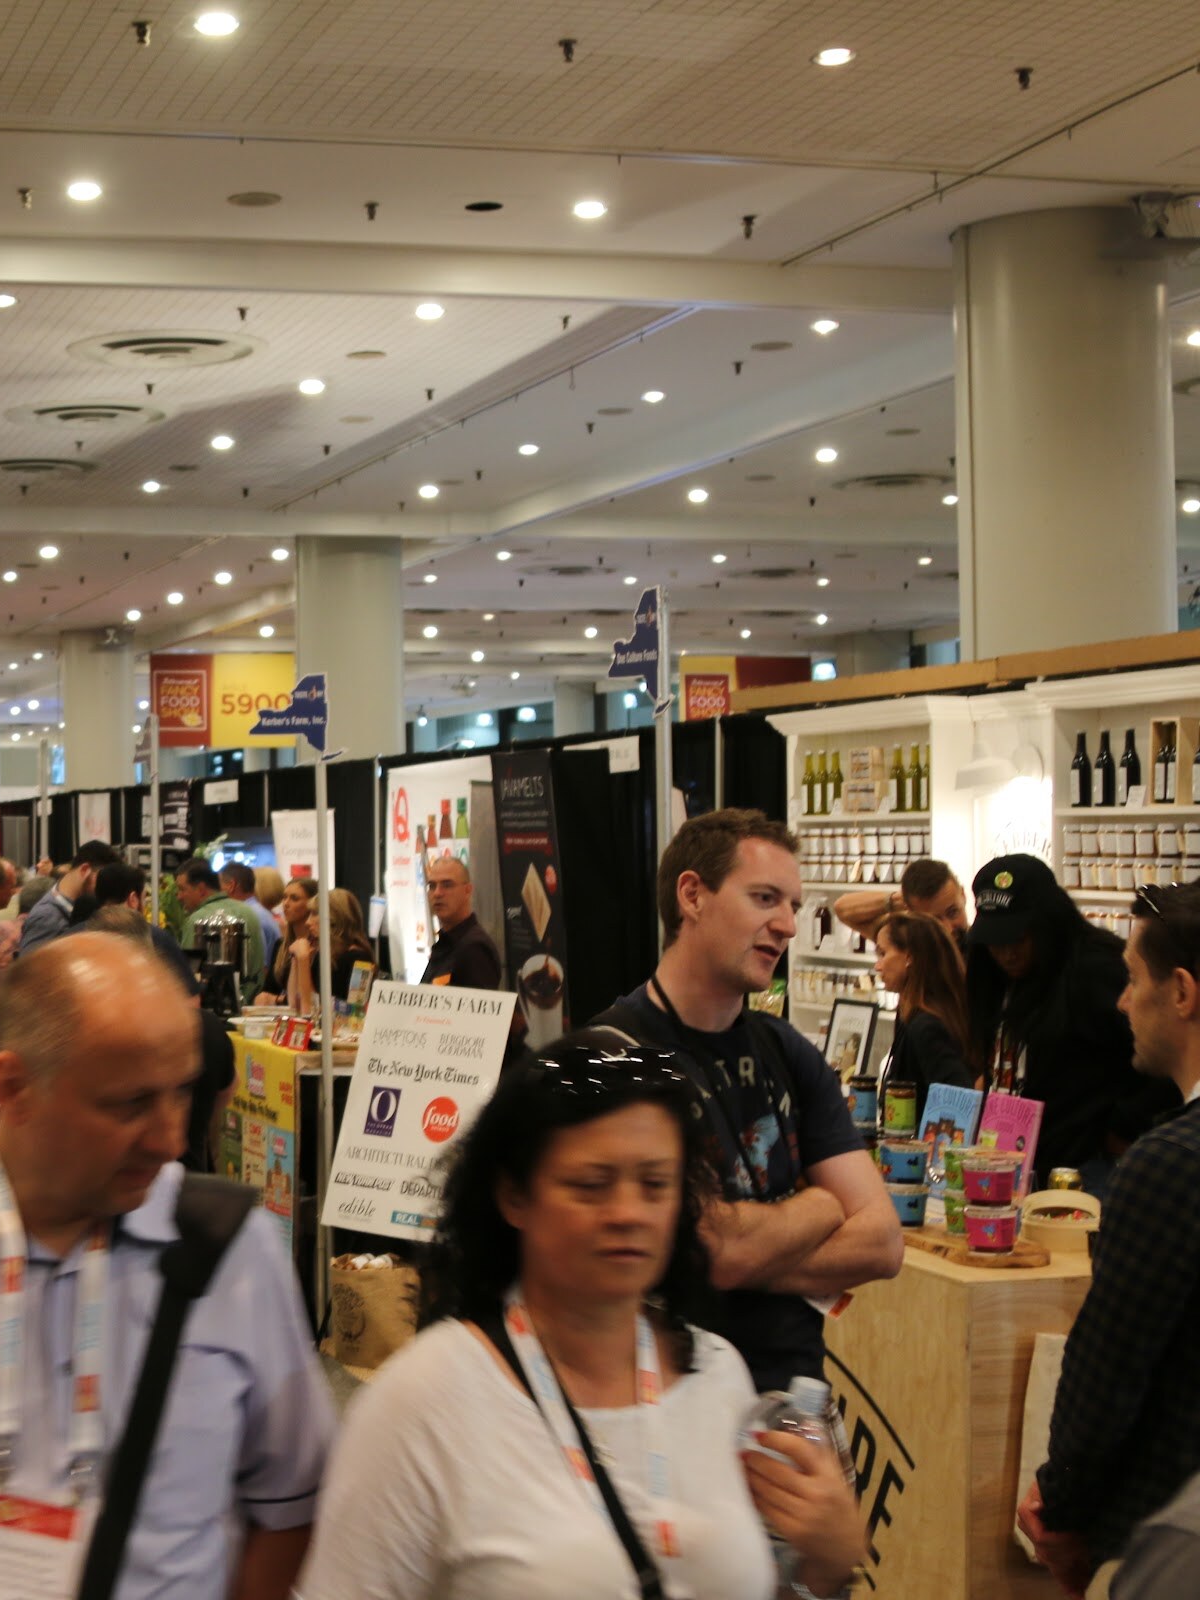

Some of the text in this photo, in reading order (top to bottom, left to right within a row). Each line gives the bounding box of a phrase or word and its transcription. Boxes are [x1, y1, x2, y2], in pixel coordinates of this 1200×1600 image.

[160, 685, 200, 697] FANCY
[160, 696, 201, 707] FOOD
[689, 696, 726, 708] FOOD
[221, 693, 291, 715] 5900
[377, 990, 503, 1016] KERBER'S FARM
[367, 1057, 480, 1086] The New York Times
[370, 1090, 397, 1123] O
[422, 1105, 460, 1131] food
[346, 1146, 425, 1169] ARCHITECTURAL
[338, 1196, 377, 1217] edible
